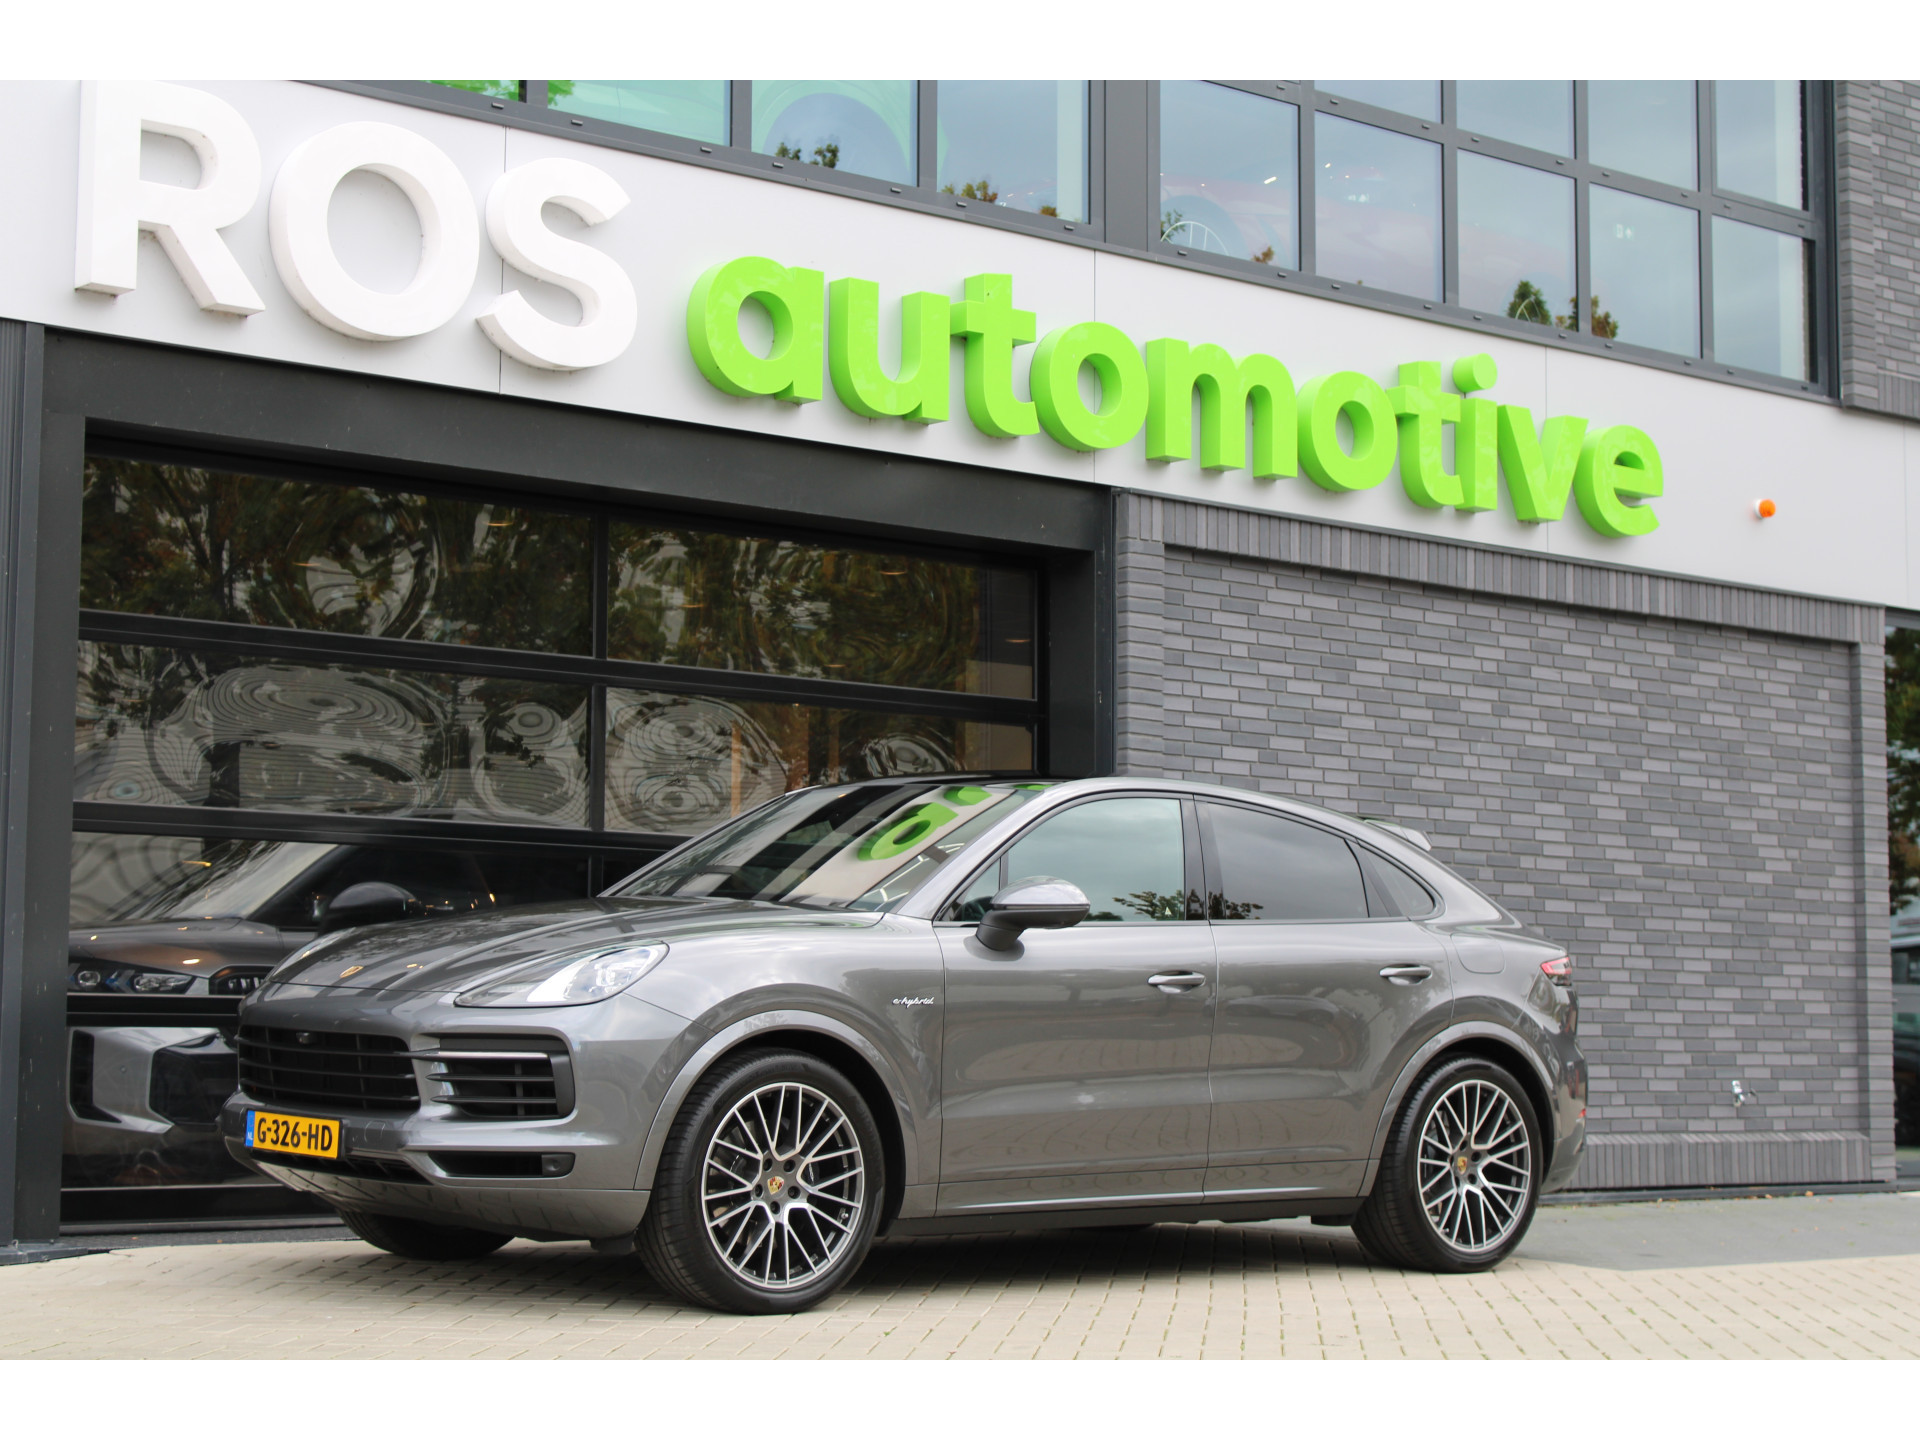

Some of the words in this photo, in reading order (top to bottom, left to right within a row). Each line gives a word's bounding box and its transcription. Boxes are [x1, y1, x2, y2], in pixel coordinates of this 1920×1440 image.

[75, 80, 638, 372] ROS
[686, 256, 1664, 538] automotive
[257, 1117, 333, 1151] G-326-HD
